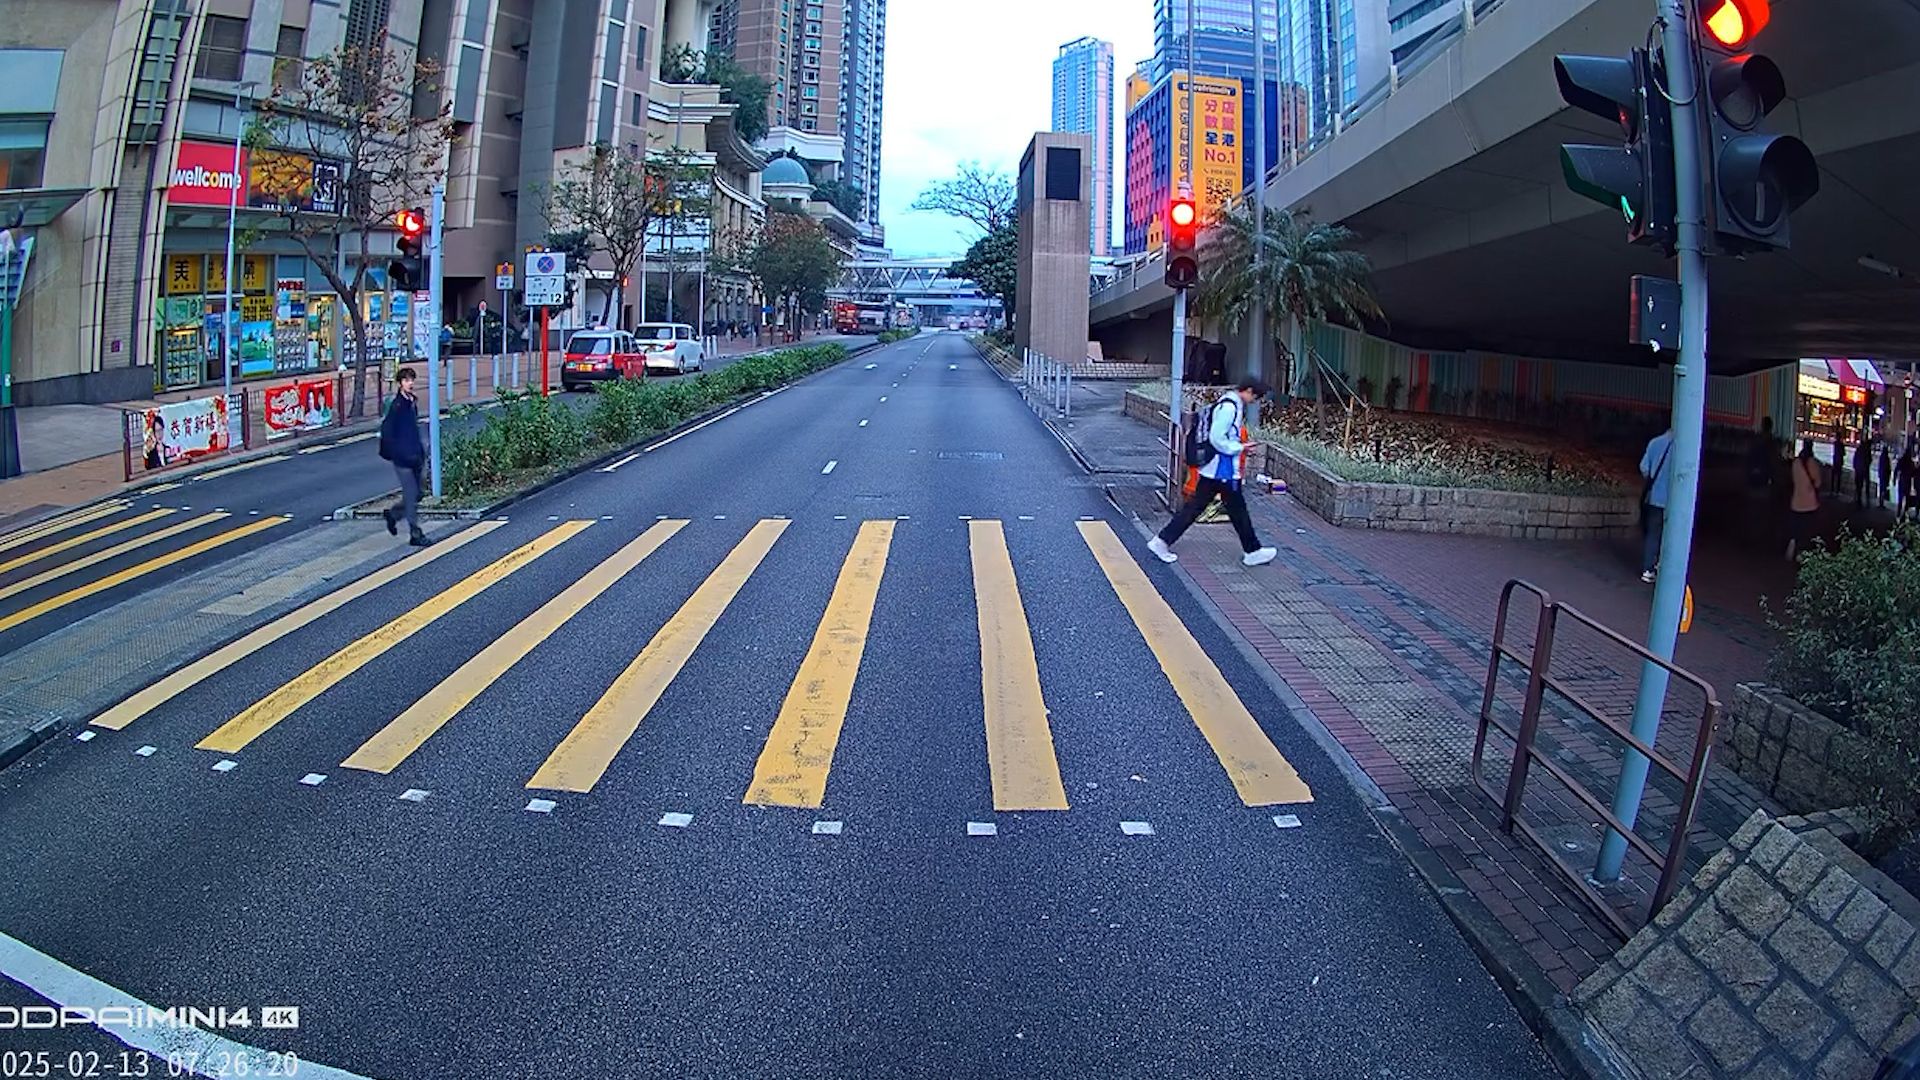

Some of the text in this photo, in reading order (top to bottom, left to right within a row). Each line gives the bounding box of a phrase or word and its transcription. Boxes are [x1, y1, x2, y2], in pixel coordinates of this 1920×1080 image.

[1205, 99, 1235, 114] 分店
[1205, 131, 1235, 147] 全港
[1205, 149, 1235, 164] No.1
[173, 165, 242, 189] wellcome
